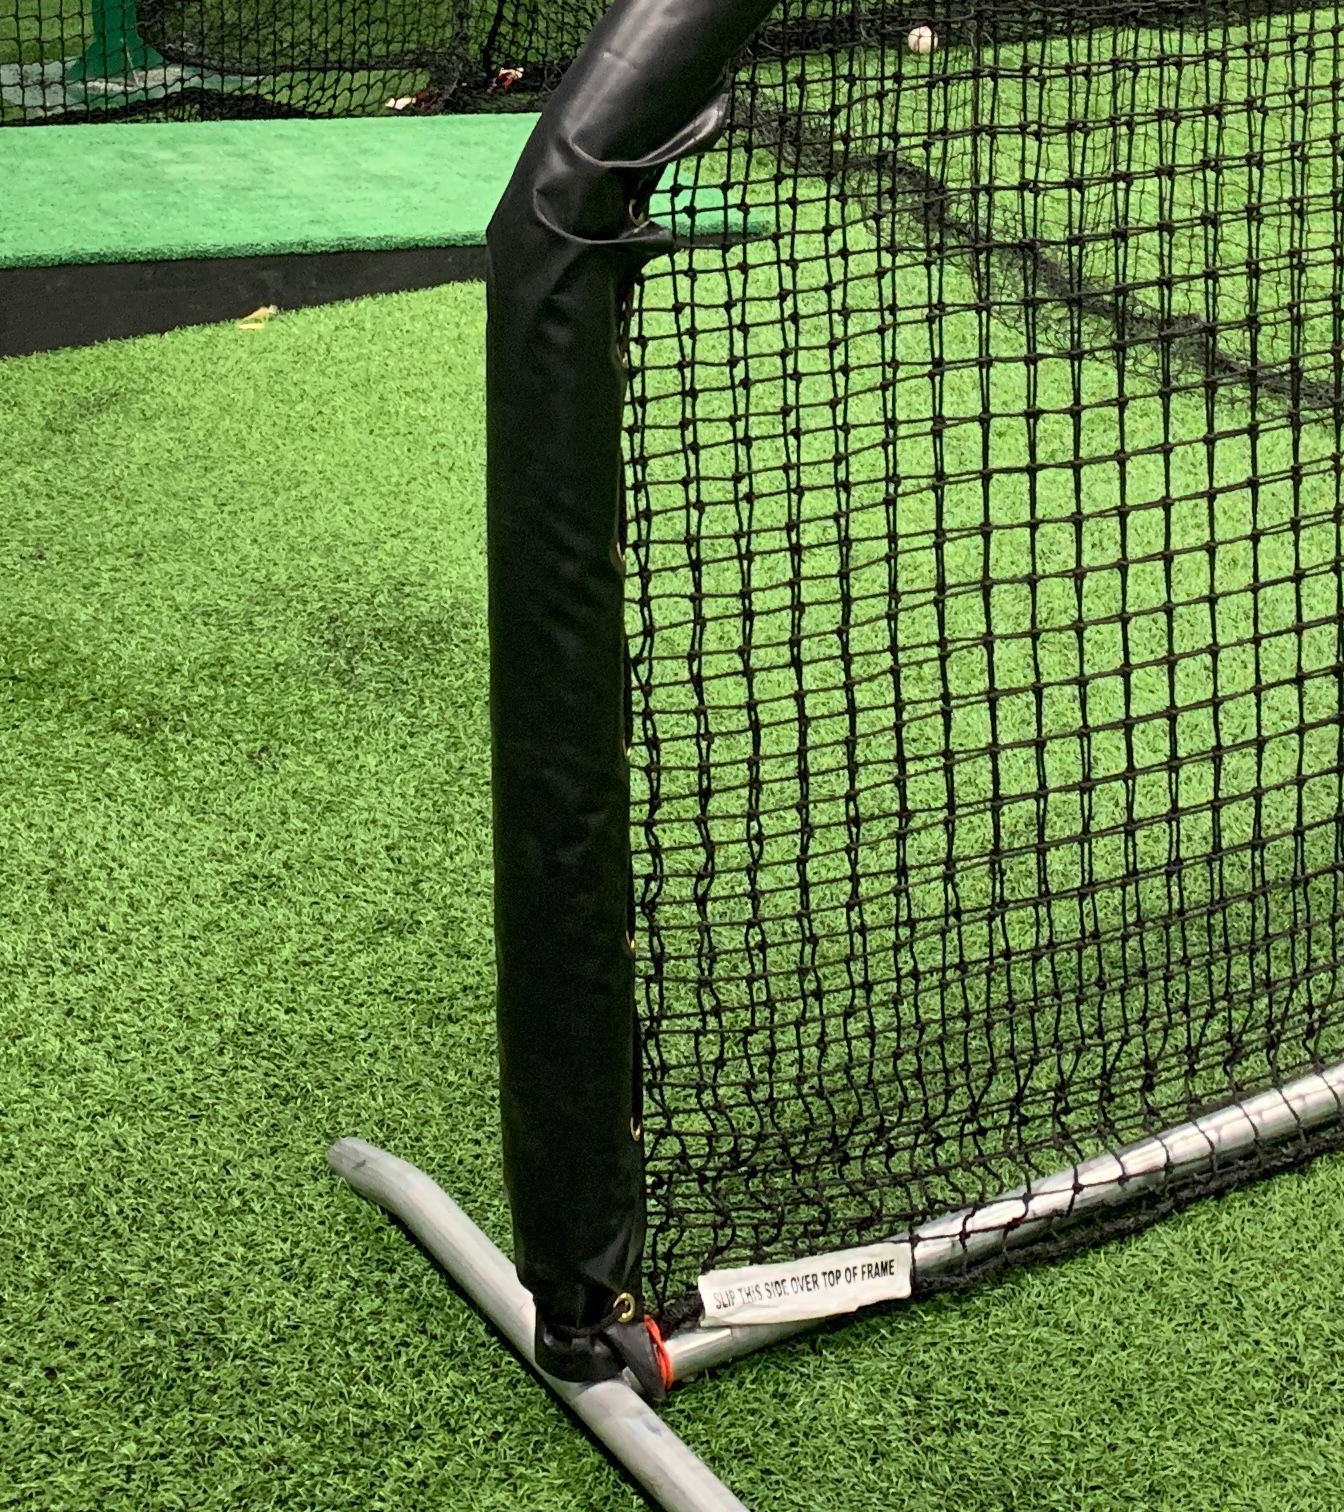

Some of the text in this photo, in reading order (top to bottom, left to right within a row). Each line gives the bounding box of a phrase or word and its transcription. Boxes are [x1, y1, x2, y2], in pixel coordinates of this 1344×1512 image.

[713, 1259, 895, 1309] SLIP THIS SIDE OVER TOP OF FRAME
